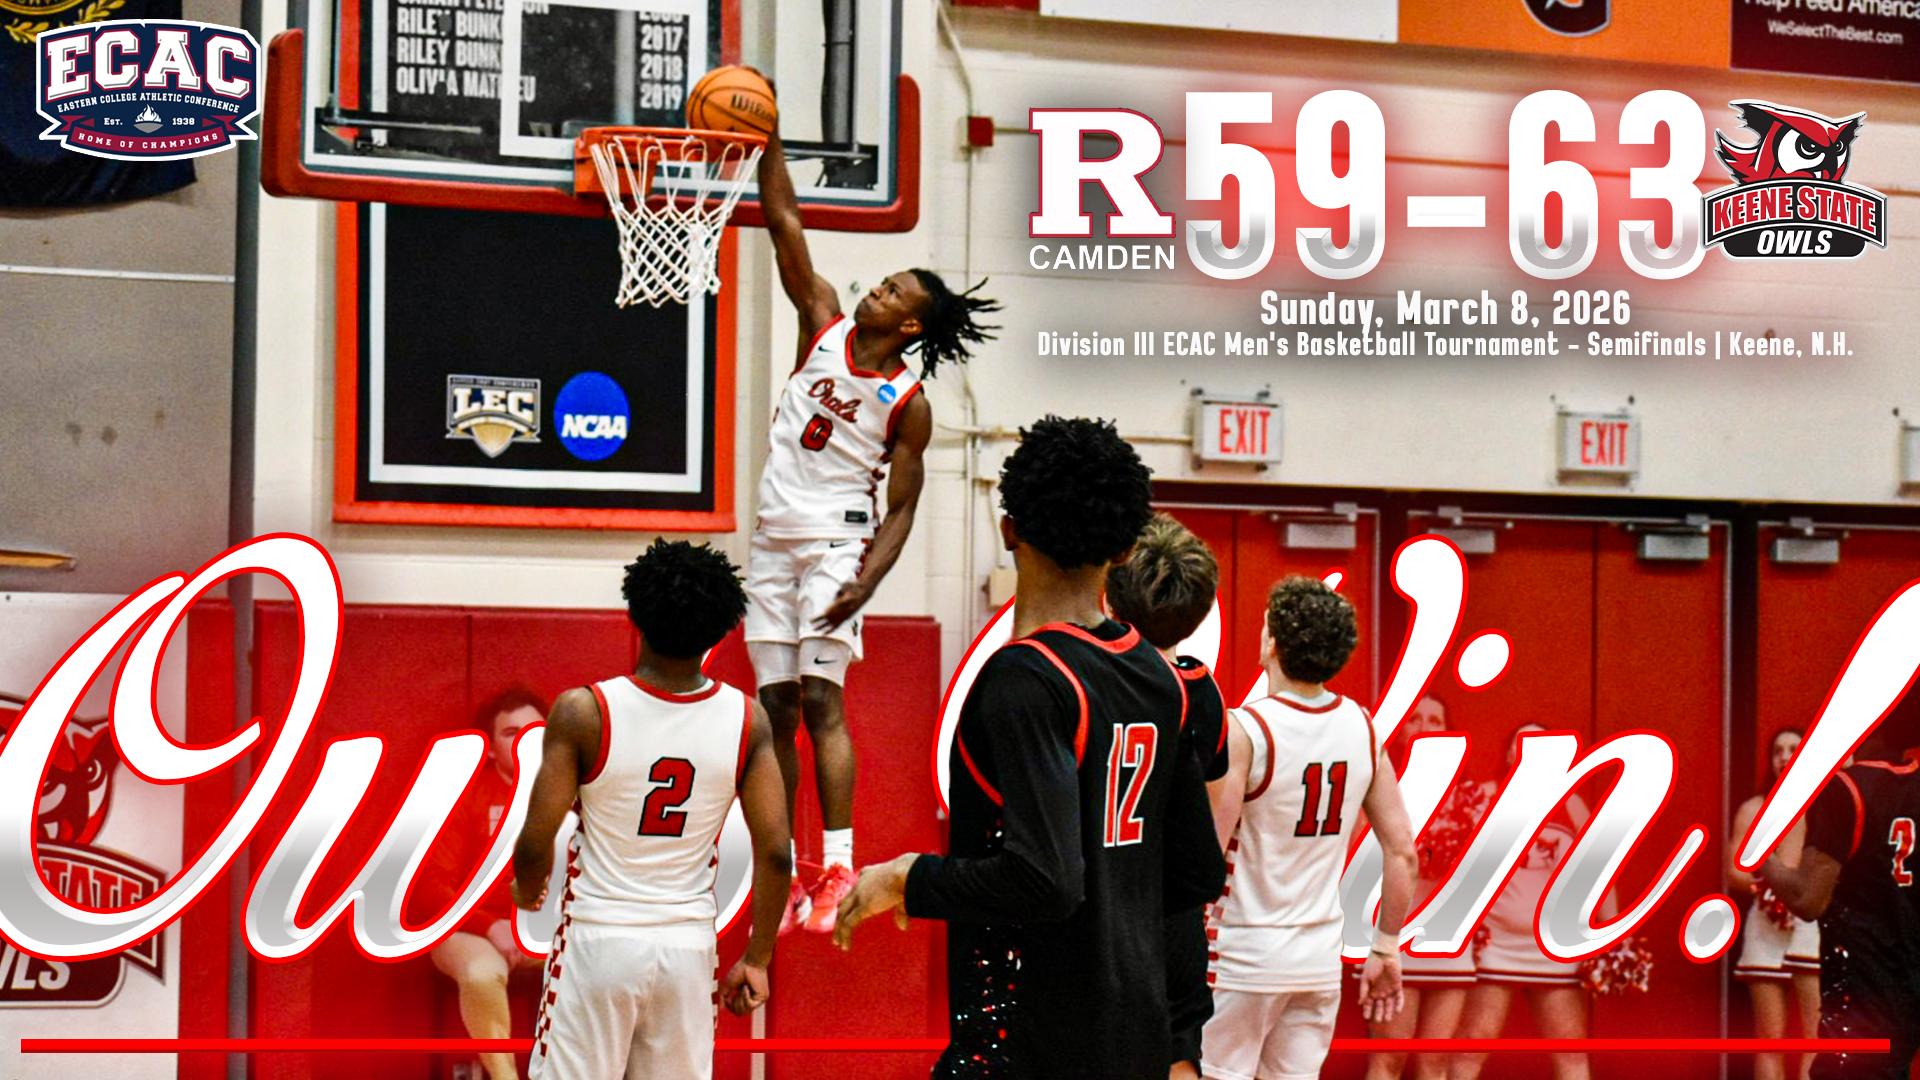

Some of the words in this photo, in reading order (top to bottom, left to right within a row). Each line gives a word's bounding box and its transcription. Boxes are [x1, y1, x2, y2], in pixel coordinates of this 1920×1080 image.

[397, 7, 451, 36] RILE
[640, 24, 683, 52] 2017
[1768, 19, 1904, 45] WeSelectTheBest.com
[397, 36, 450, 66] RILEY
[640, 53, 683, 82] 2018
[640, 82, 683, 110] 2019
[453, 388, 534, 423] LEC
[561, 413, 628, 440] NCAA
[1219, 409, 1271, 455] EXIT
[1580, 421, 1629, 466] EXIT
[637, 756, 696, 837] 2
[1103, 722, 1158, 848] 12
[1294, 761, 1348, 837] 11
